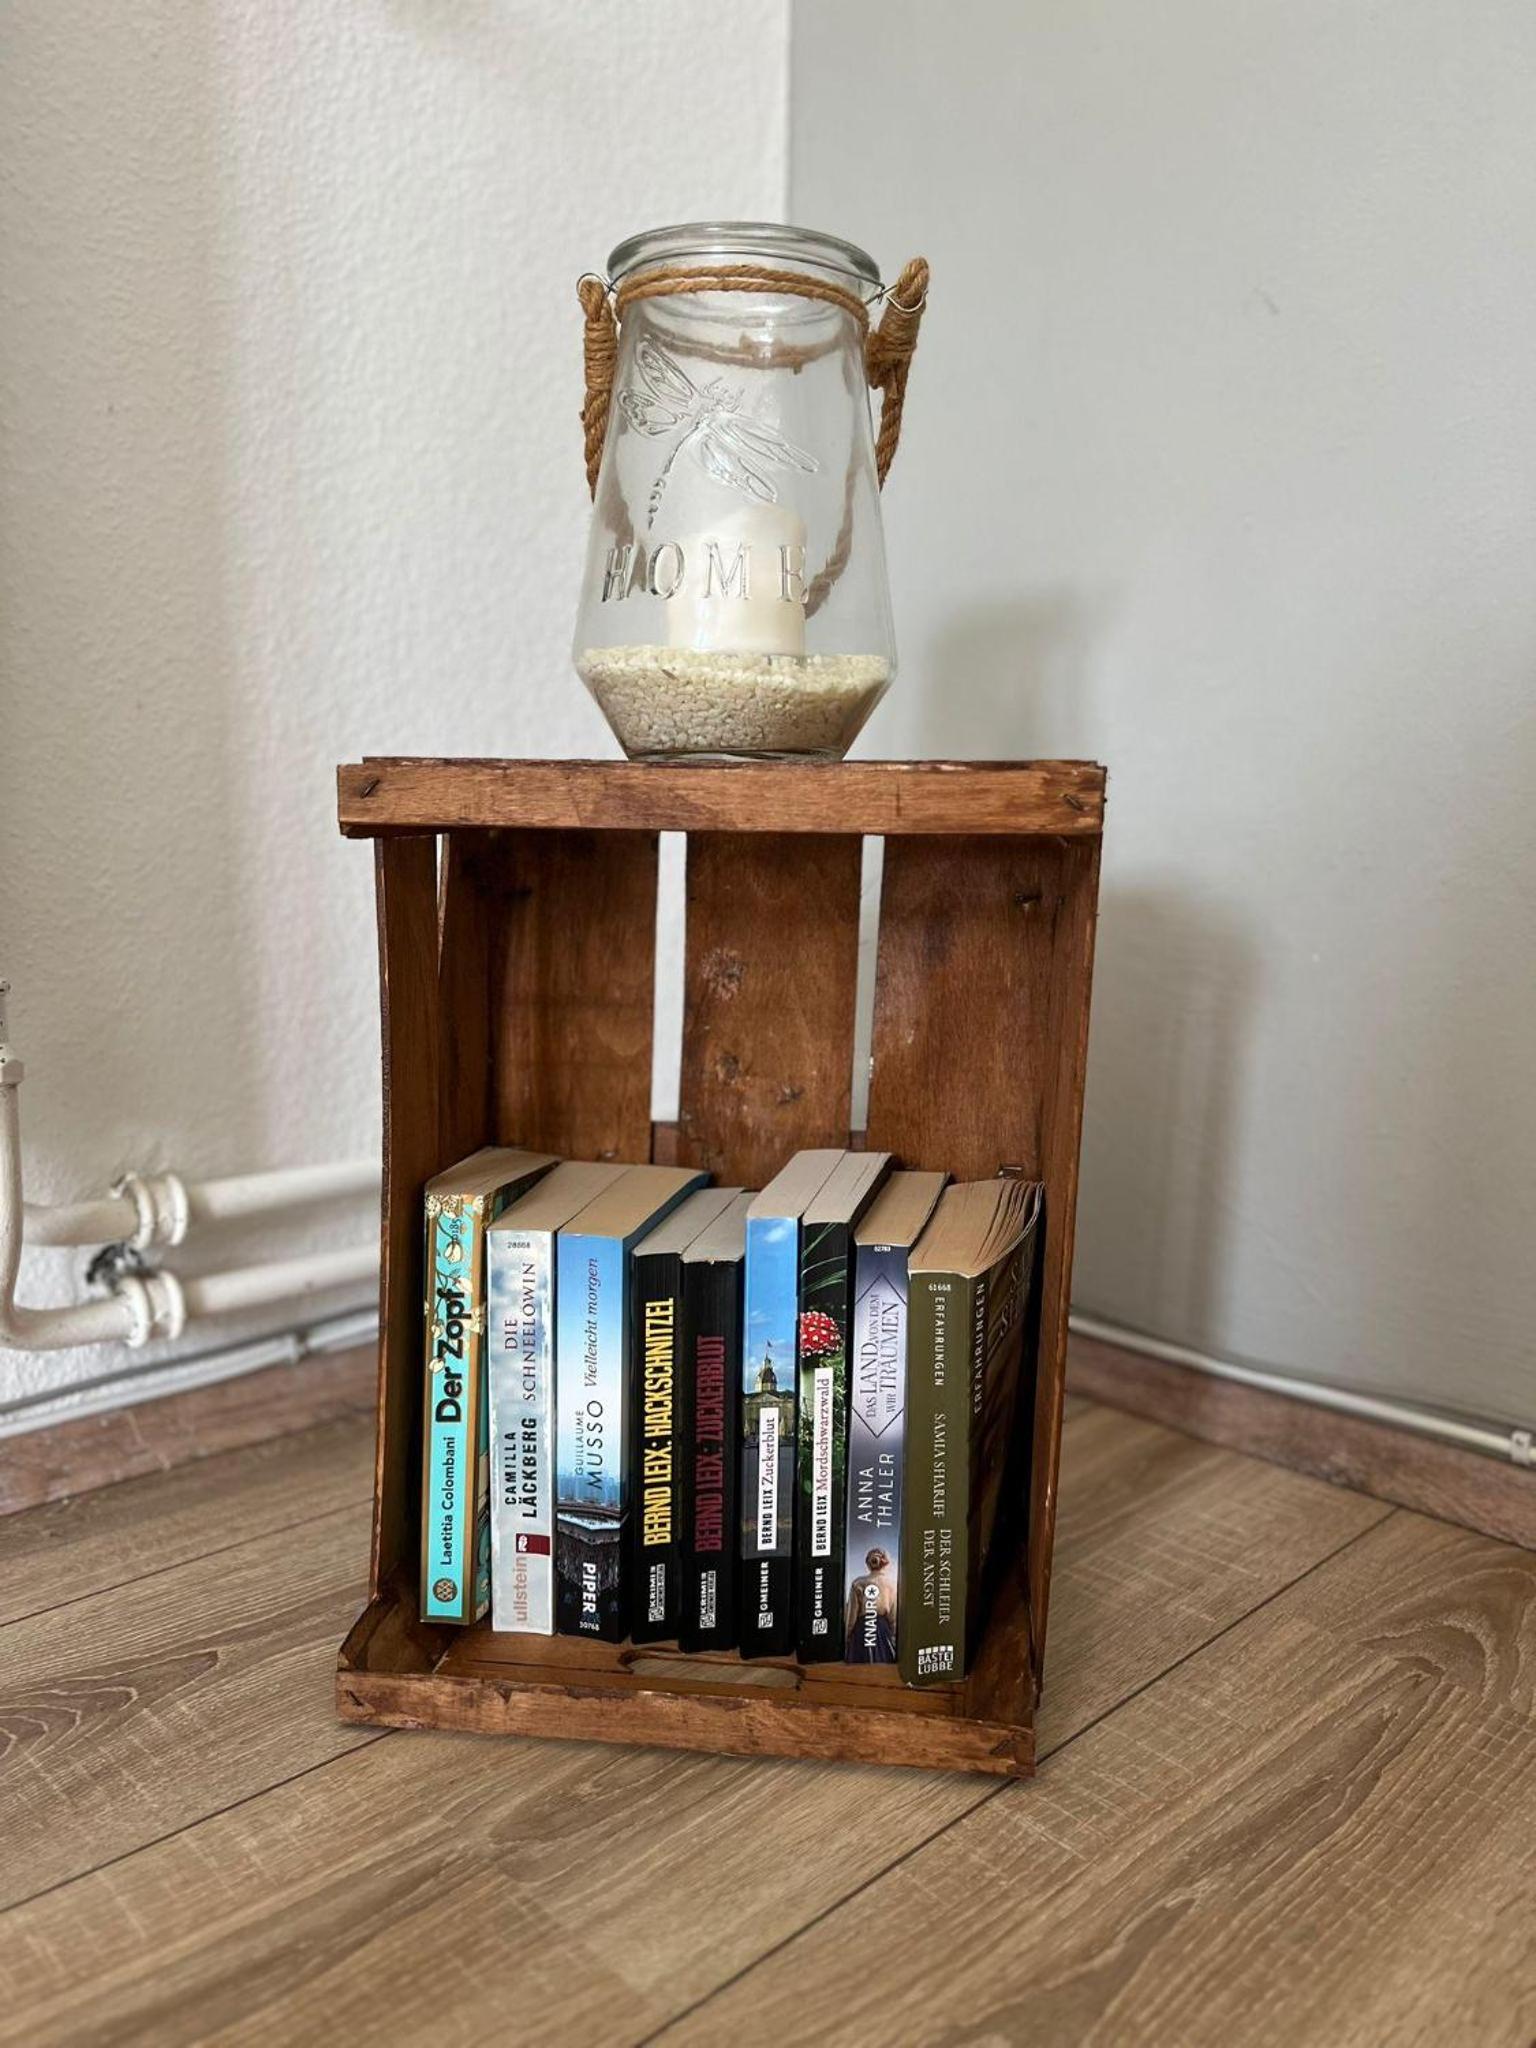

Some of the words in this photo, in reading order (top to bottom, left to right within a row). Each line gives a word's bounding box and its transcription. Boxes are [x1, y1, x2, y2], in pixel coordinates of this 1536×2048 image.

[602, 542, 809, 602] HOME
[588, 1257, 601, 1317] morgen
[869, 1294, 880, 1318] DEM
[436, 1288, 472, 1360] Zopf
[504, 1319, 518, 1350] DIE
[869, 1319, 879, 1341] VON
[934, 1296, 946, 1387] ERFAHRUNGEN
[973, 1283, 986, 1415] ERFAHRUNGEN
[584, 1319, 598, 1388] Vielleicht
[644, 1297, 674, 1438] HACKSCHNITZEL
[435, 1367, 463, 1422] Der
[696, 1335, 724, 1443] ZUCKERBLUT
[866, 1396, 877, 1417] DAS
[886, 1393, 897, 1413] WIR
[574, 1410, 585, 1476] GUILLAUME
[586, 1400, 603, 1490] MUSSO
[644, 1440, 673, 1484] LEIX:
[761, 1417, 775, 1486] Zuckerblut
[815, 1378, 830, 1491] Mordschwarzwald
[933, 1413, 946, 1459] SAMIA
[441, 1437, 456, 1510] Colombani
[504, 1431, 517, 1506] CAMILLA
[518, 1417, 538, 1518] LÄCKBERG
[695, 1446, 724, 1490] LEIX:
[858, 1467, 874, 1523] ANNA
[877, 1453, 895, 1528] THALER
[933, 1461, 946, 1518] SHARIFF
[643, 1485, 673, 1546] BERND
[694, 1493, 723, 1552] BERND
[762, 1489, 773, 1511] LEIX
[817, 1494, 828, 1516] LEIX
[440, 1514, 453, 1566] Laetitia
[762, 1513, 773, 1545] BERND
[816, 1518, 827, 1551] BERND
[924, 1529, 936, 1560] DER
[940, 1529, 952, 1557] DER
[513, 1556, 528, 1622] ullstein
[582, 1562, 597, 1613] PIPER
[760, 1561, 770, 1612] GMEINER
[814, 1567, 824, 1618] GMEINER
[923, 1561, 936, 1608] ANGST
[938, 1560, 952, 1625] SCHLEIER
[864, 1601, 878, 1647] KNAUR
[917, 1652, 954, 1665] BASTEI
